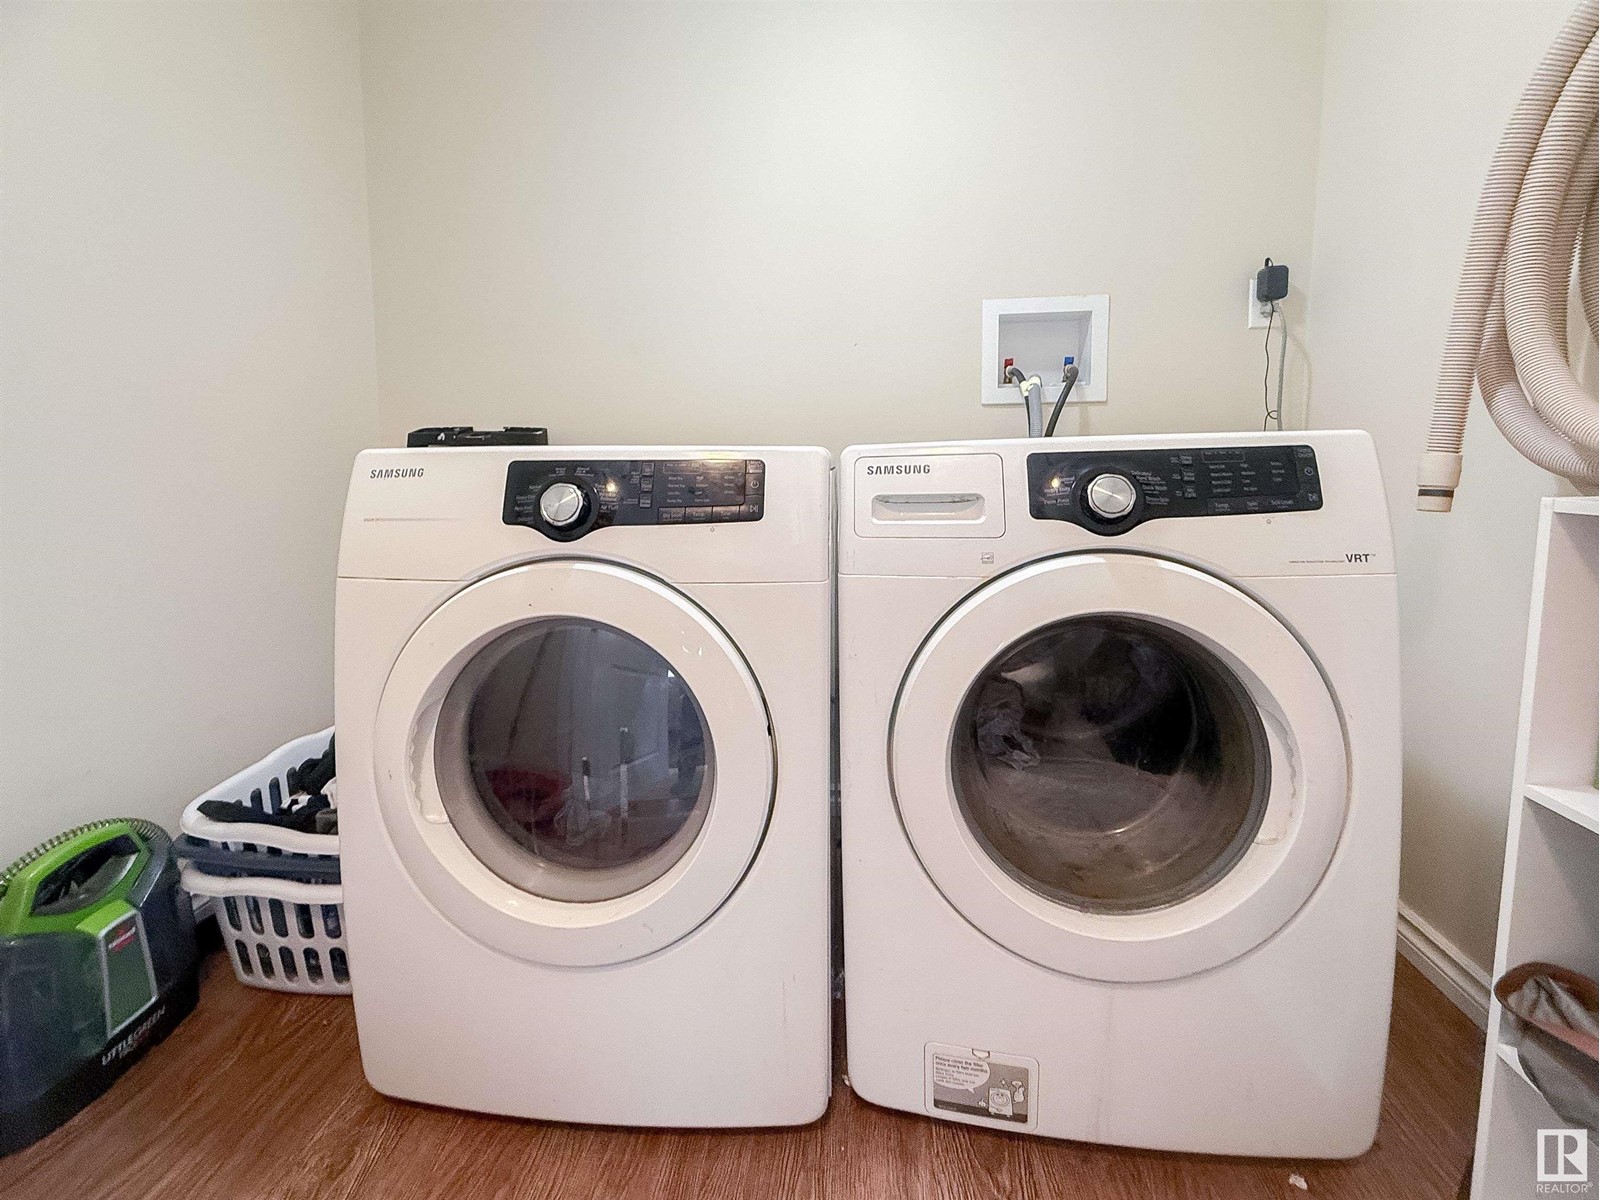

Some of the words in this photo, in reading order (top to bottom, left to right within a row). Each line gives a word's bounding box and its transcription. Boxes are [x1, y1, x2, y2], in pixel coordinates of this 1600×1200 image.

[369, 468, 425, 479] SAMSUNG
[867, 464, 931, 475] SAMSUNG
[1345, 553, 1370, 563] VRT
